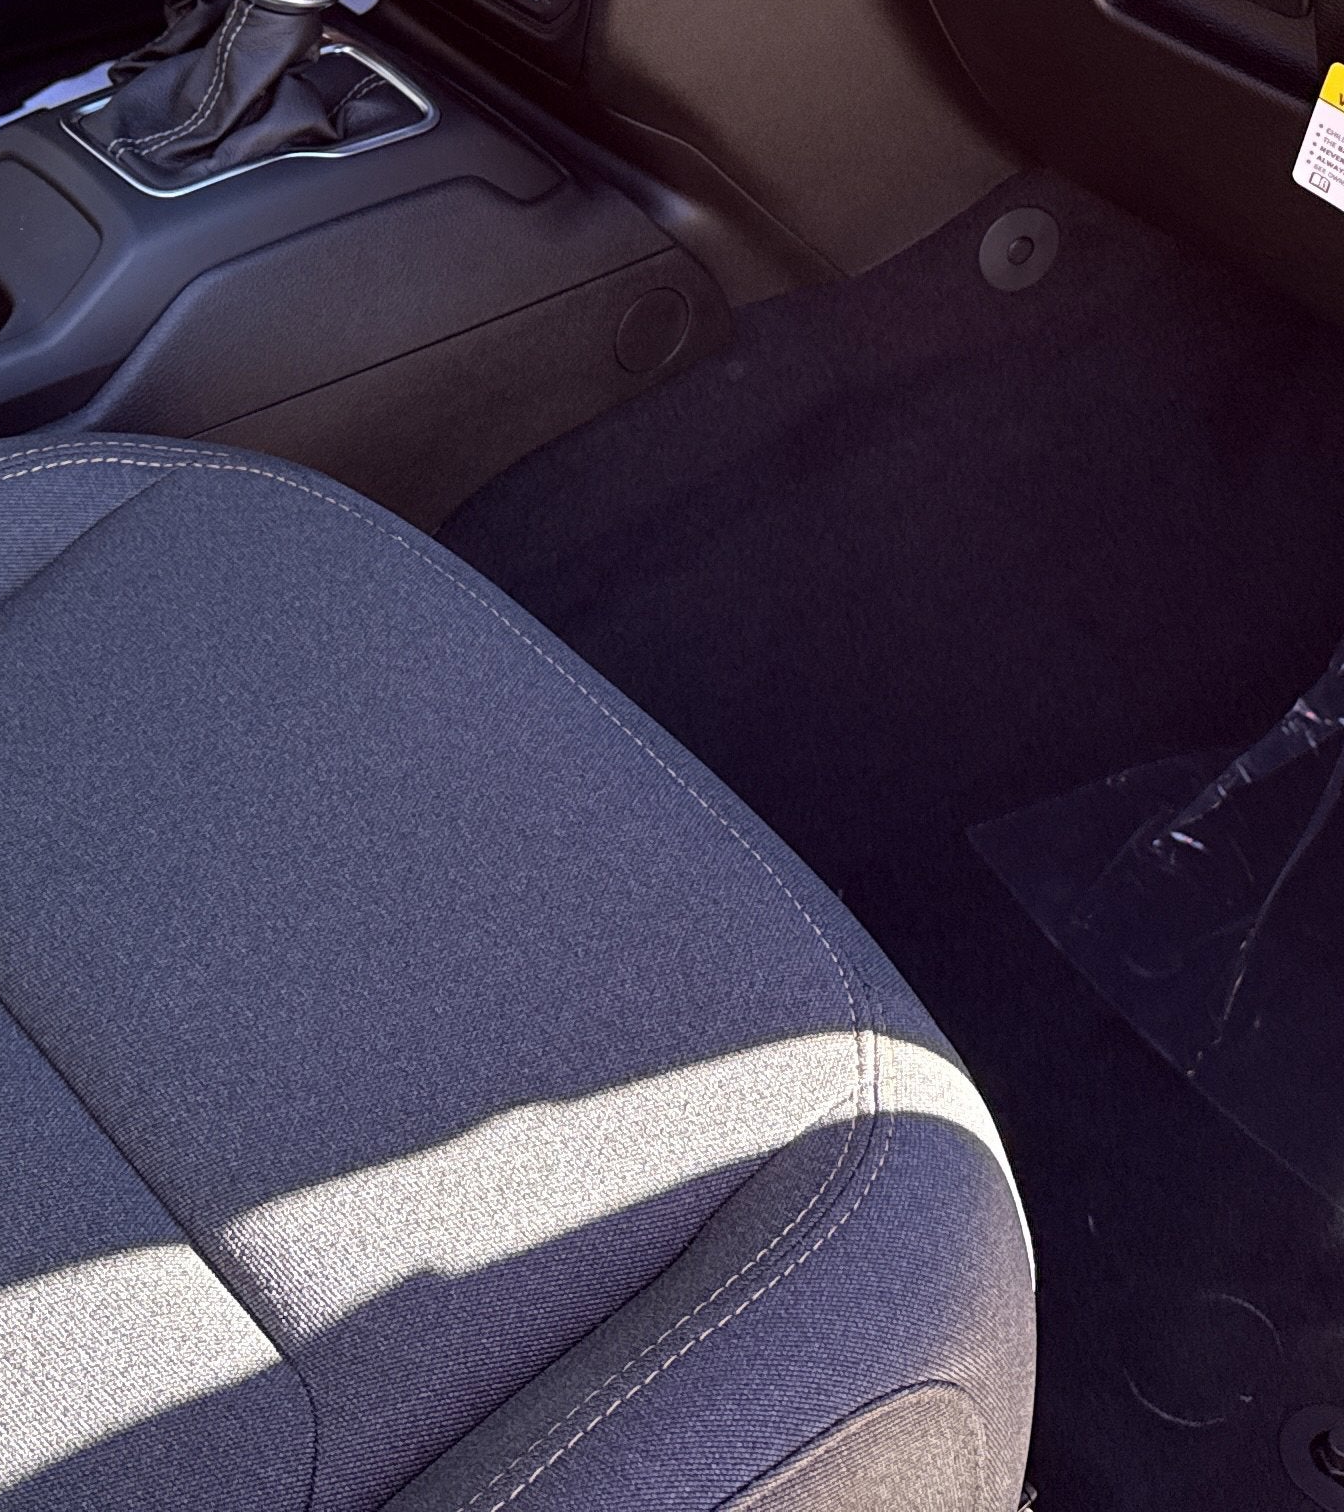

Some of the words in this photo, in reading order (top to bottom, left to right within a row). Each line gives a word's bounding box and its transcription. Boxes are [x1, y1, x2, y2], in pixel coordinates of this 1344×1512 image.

[1322, 136, 1336, 148] THE
[1319, 144, 1344, 164] NEVER
[1313, 162, 1326, 174] SEE
